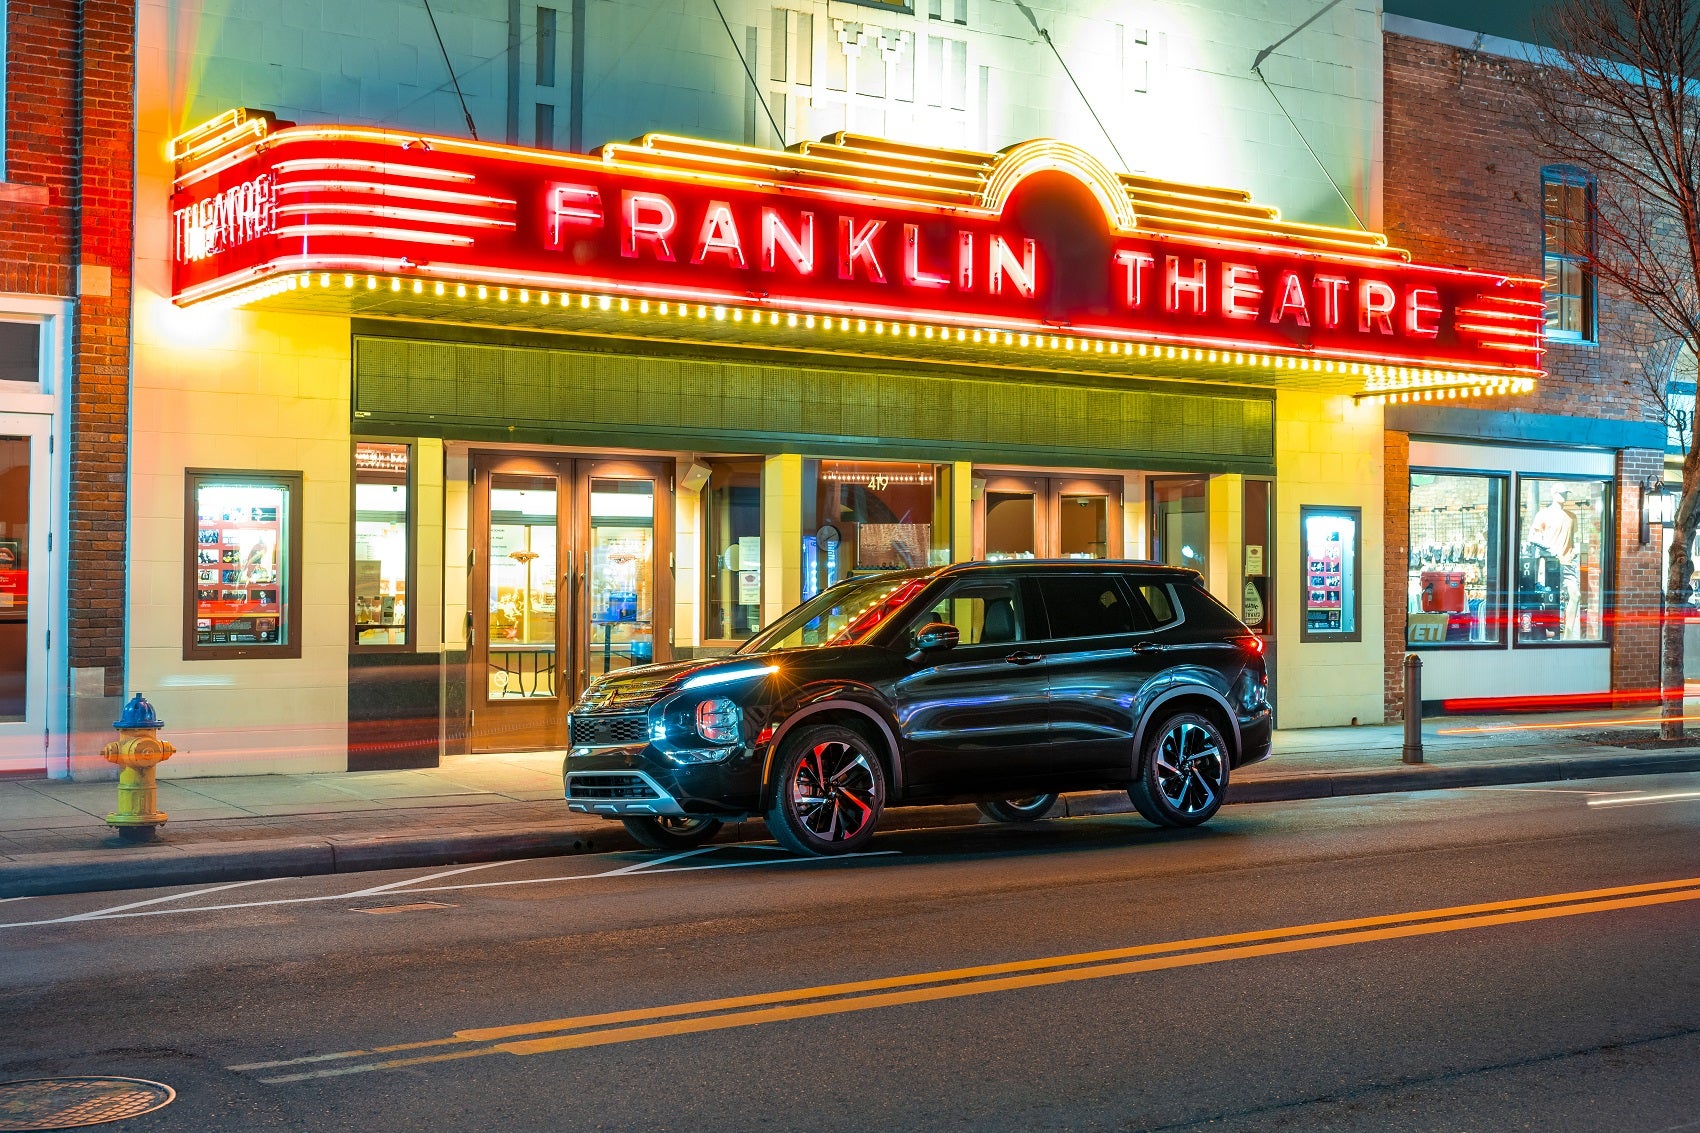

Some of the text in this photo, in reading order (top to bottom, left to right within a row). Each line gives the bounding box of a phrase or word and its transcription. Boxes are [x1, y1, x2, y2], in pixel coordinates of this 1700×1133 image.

[544, 180, 1443, 339] FRANKLIN THEATRE
[867, 475, 889, 491] 419
